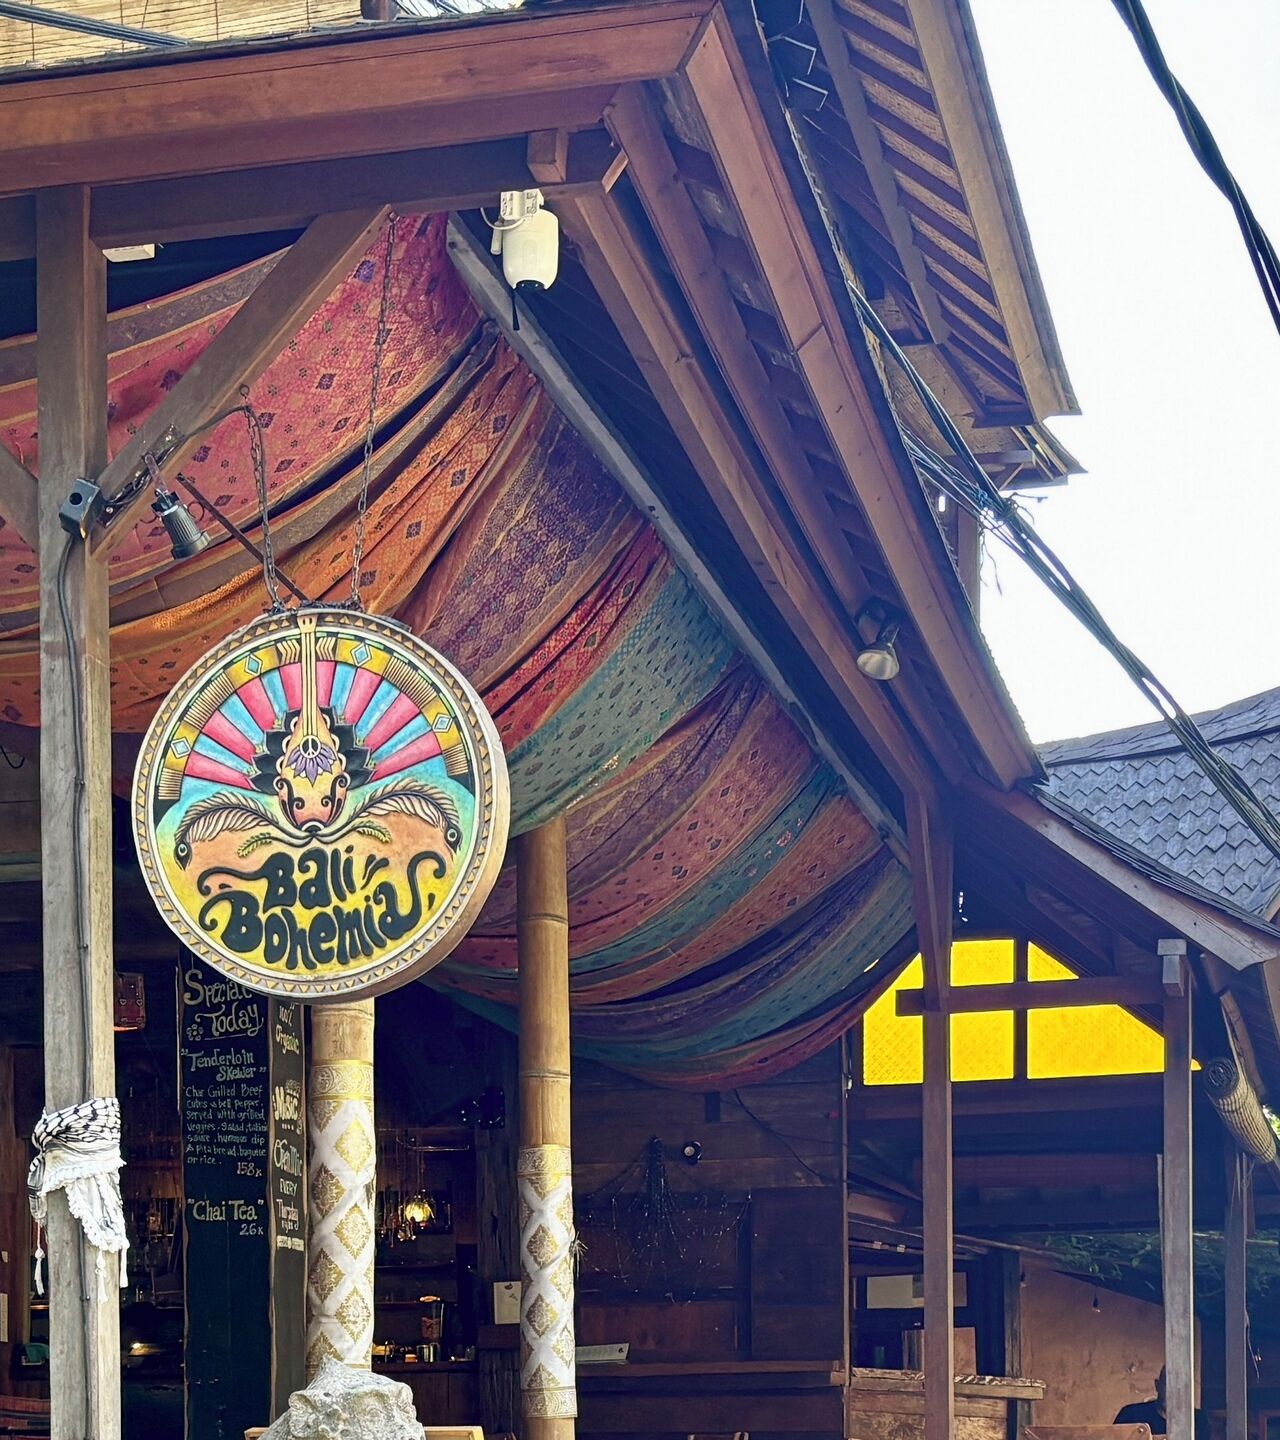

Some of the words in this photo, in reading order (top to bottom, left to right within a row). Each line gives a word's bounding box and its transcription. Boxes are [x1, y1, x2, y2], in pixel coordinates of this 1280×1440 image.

[197, 845, 357, 914] Bali
[199, 851, 447, 970] Bohemia
[195, 1001, 264, 1036] Today
[208, 1084, 236, 1097] Grilled
[241, 1083, 263, 1098] Beef
[251, 1133, 265, 1146] dip
